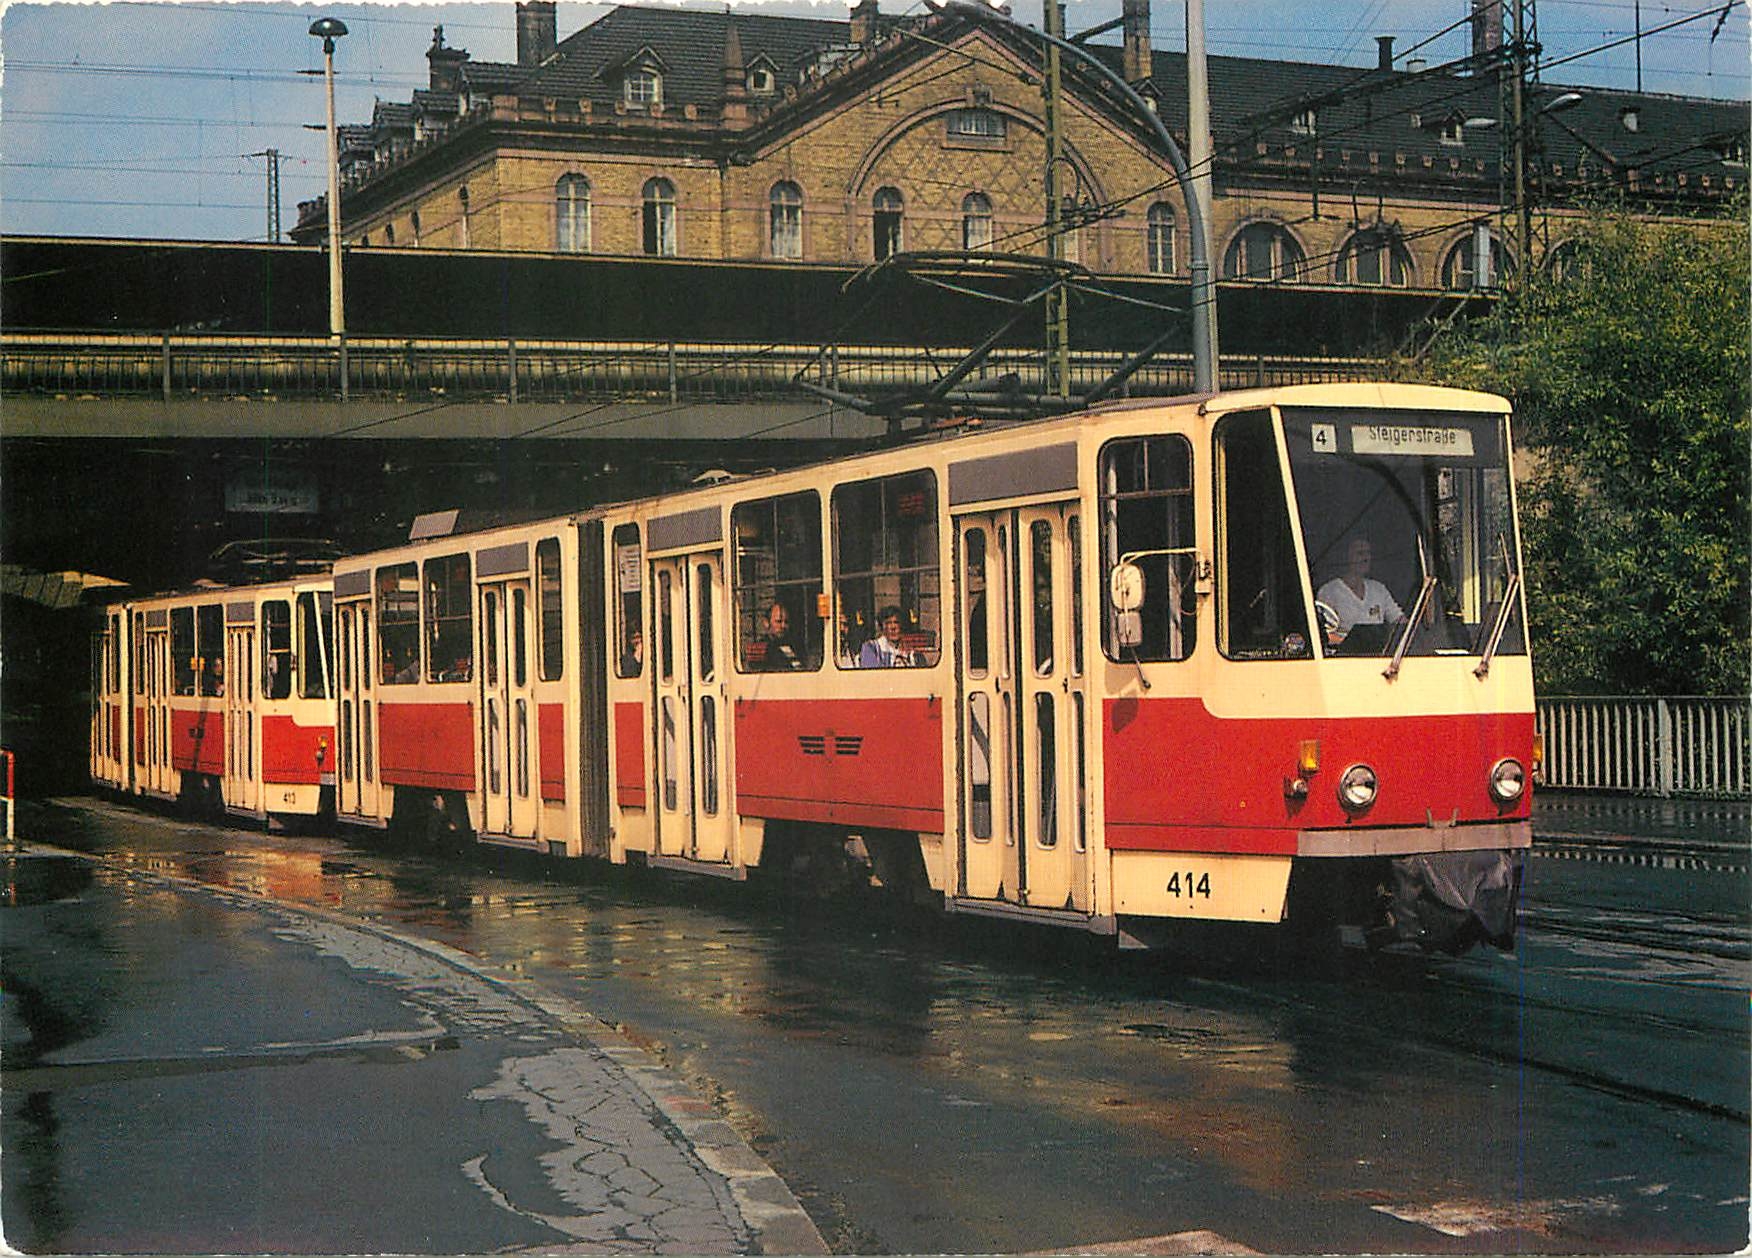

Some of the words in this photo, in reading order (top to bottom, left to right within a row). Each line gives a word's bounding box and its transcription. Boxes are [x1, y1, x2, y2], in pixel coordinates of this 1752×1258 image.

[1315, 430, 1327, 445] 4
[1369, 426, 1456, 445] Steigerstraße
[1166, 872, 1211, 898] 414
